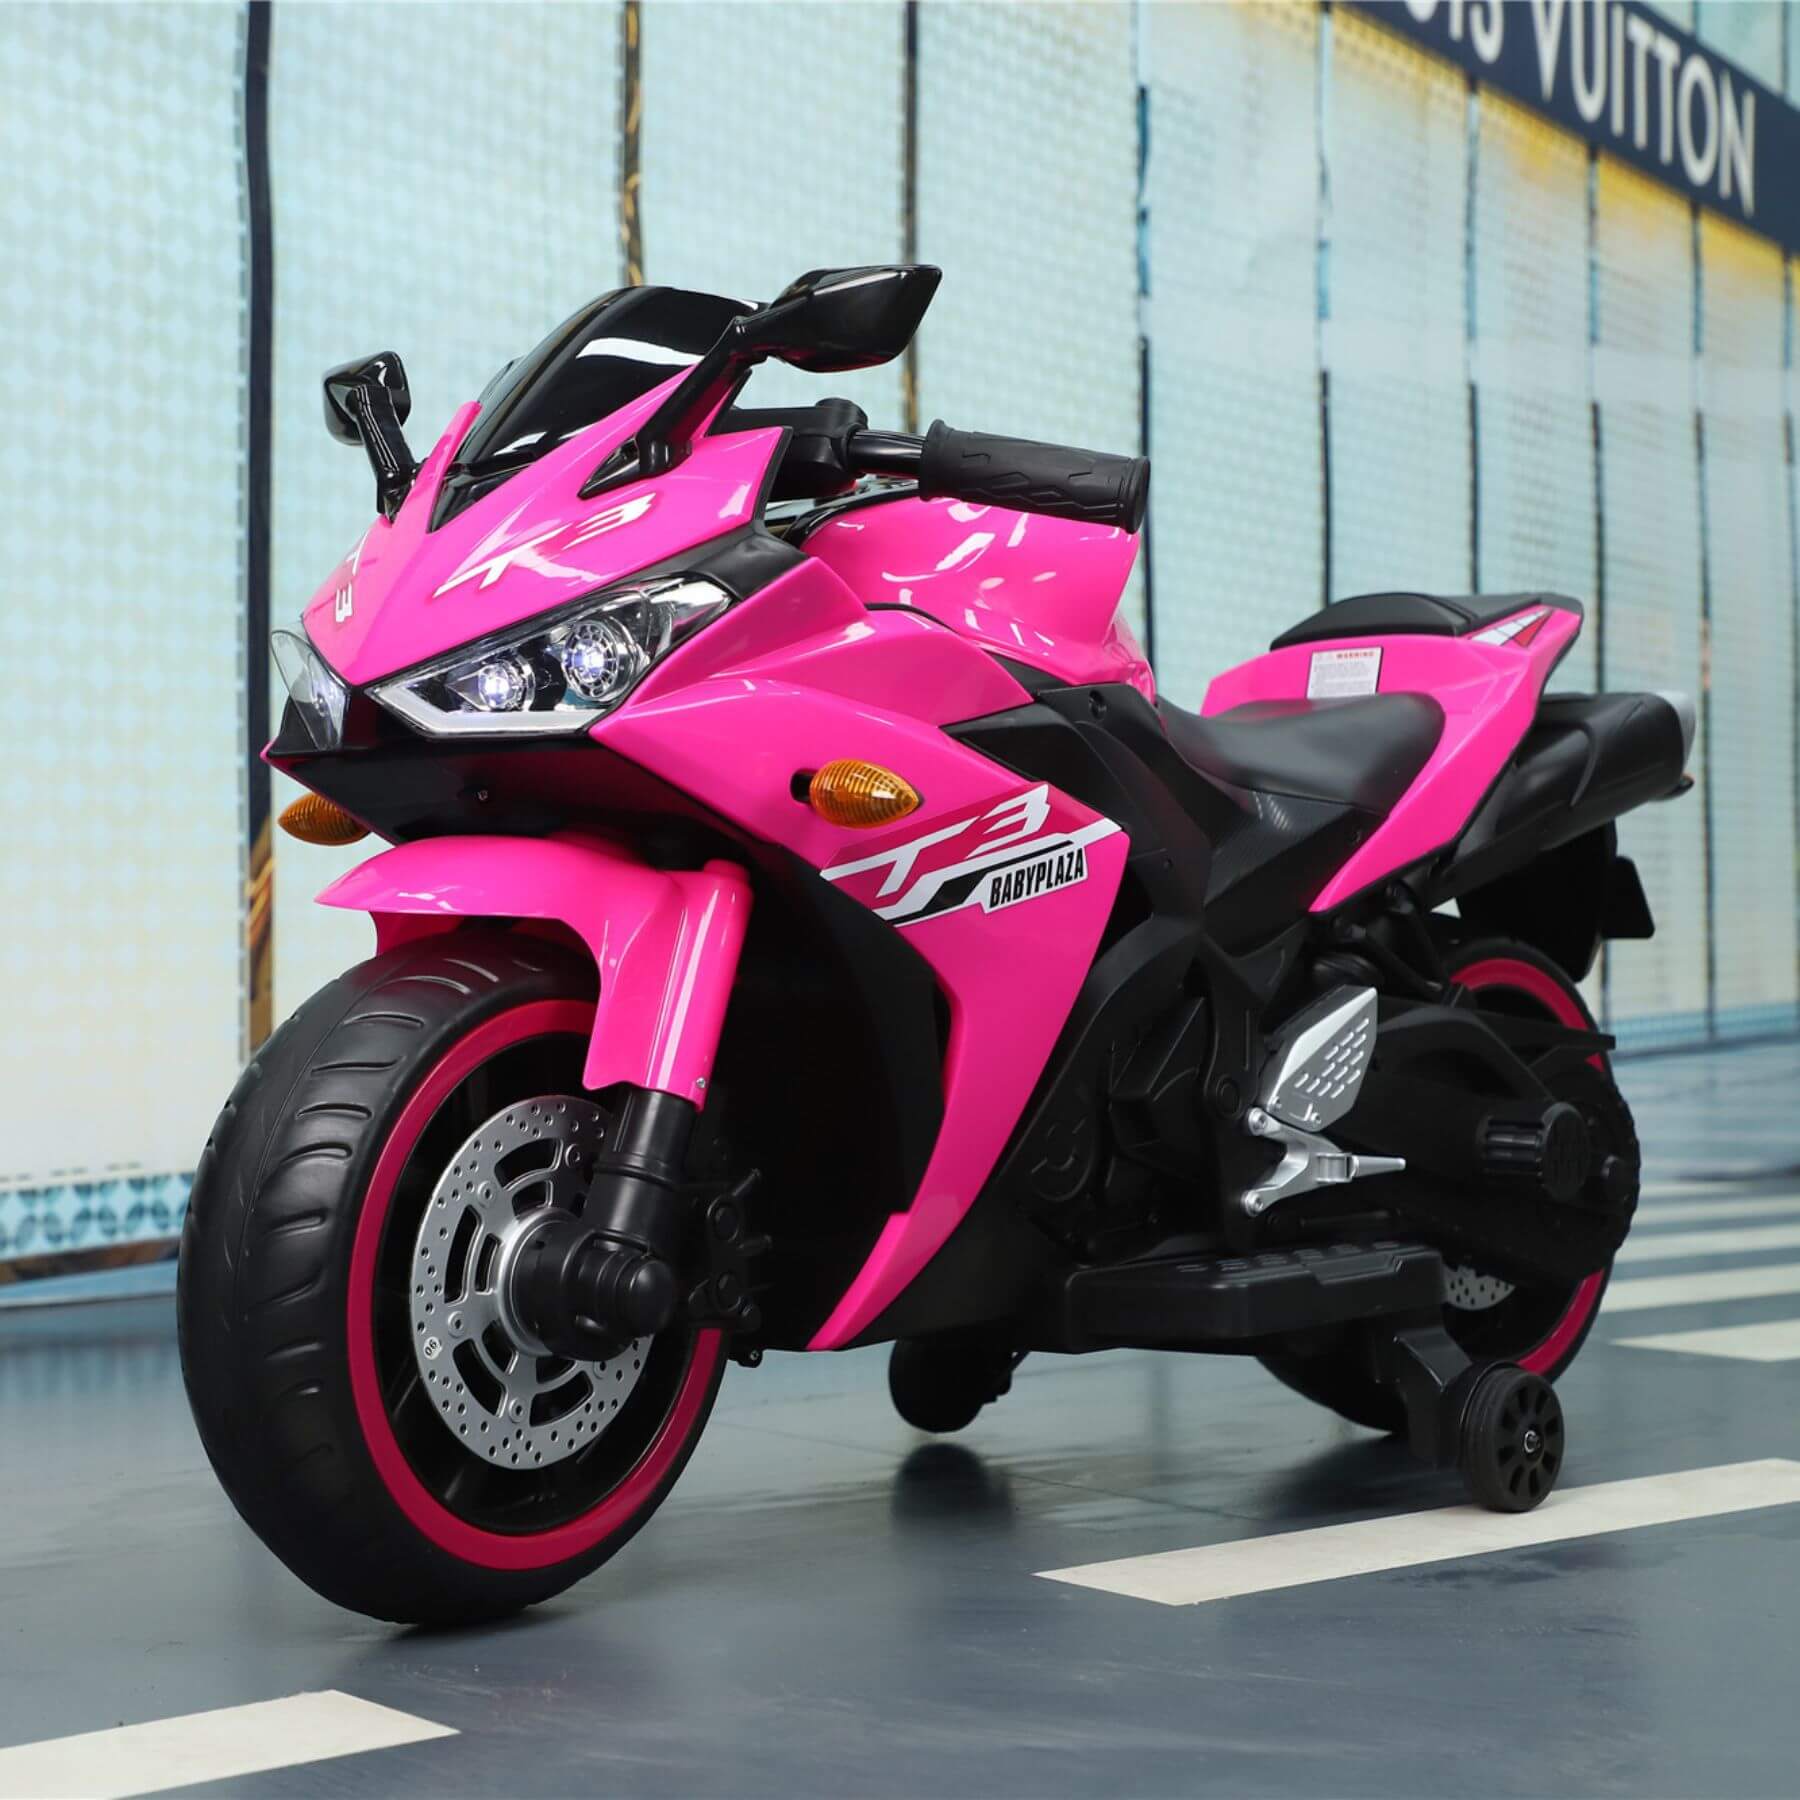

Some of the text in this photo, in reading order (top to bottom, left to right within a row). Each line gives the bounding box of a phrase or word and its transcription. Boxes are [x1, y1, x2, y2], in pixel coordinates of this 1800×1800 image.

[1531, 0, 1756, 217] VUITTON
[820, 784, 1051, 898] T3
[989, 847, 1085, 909] BABYPLAZA
